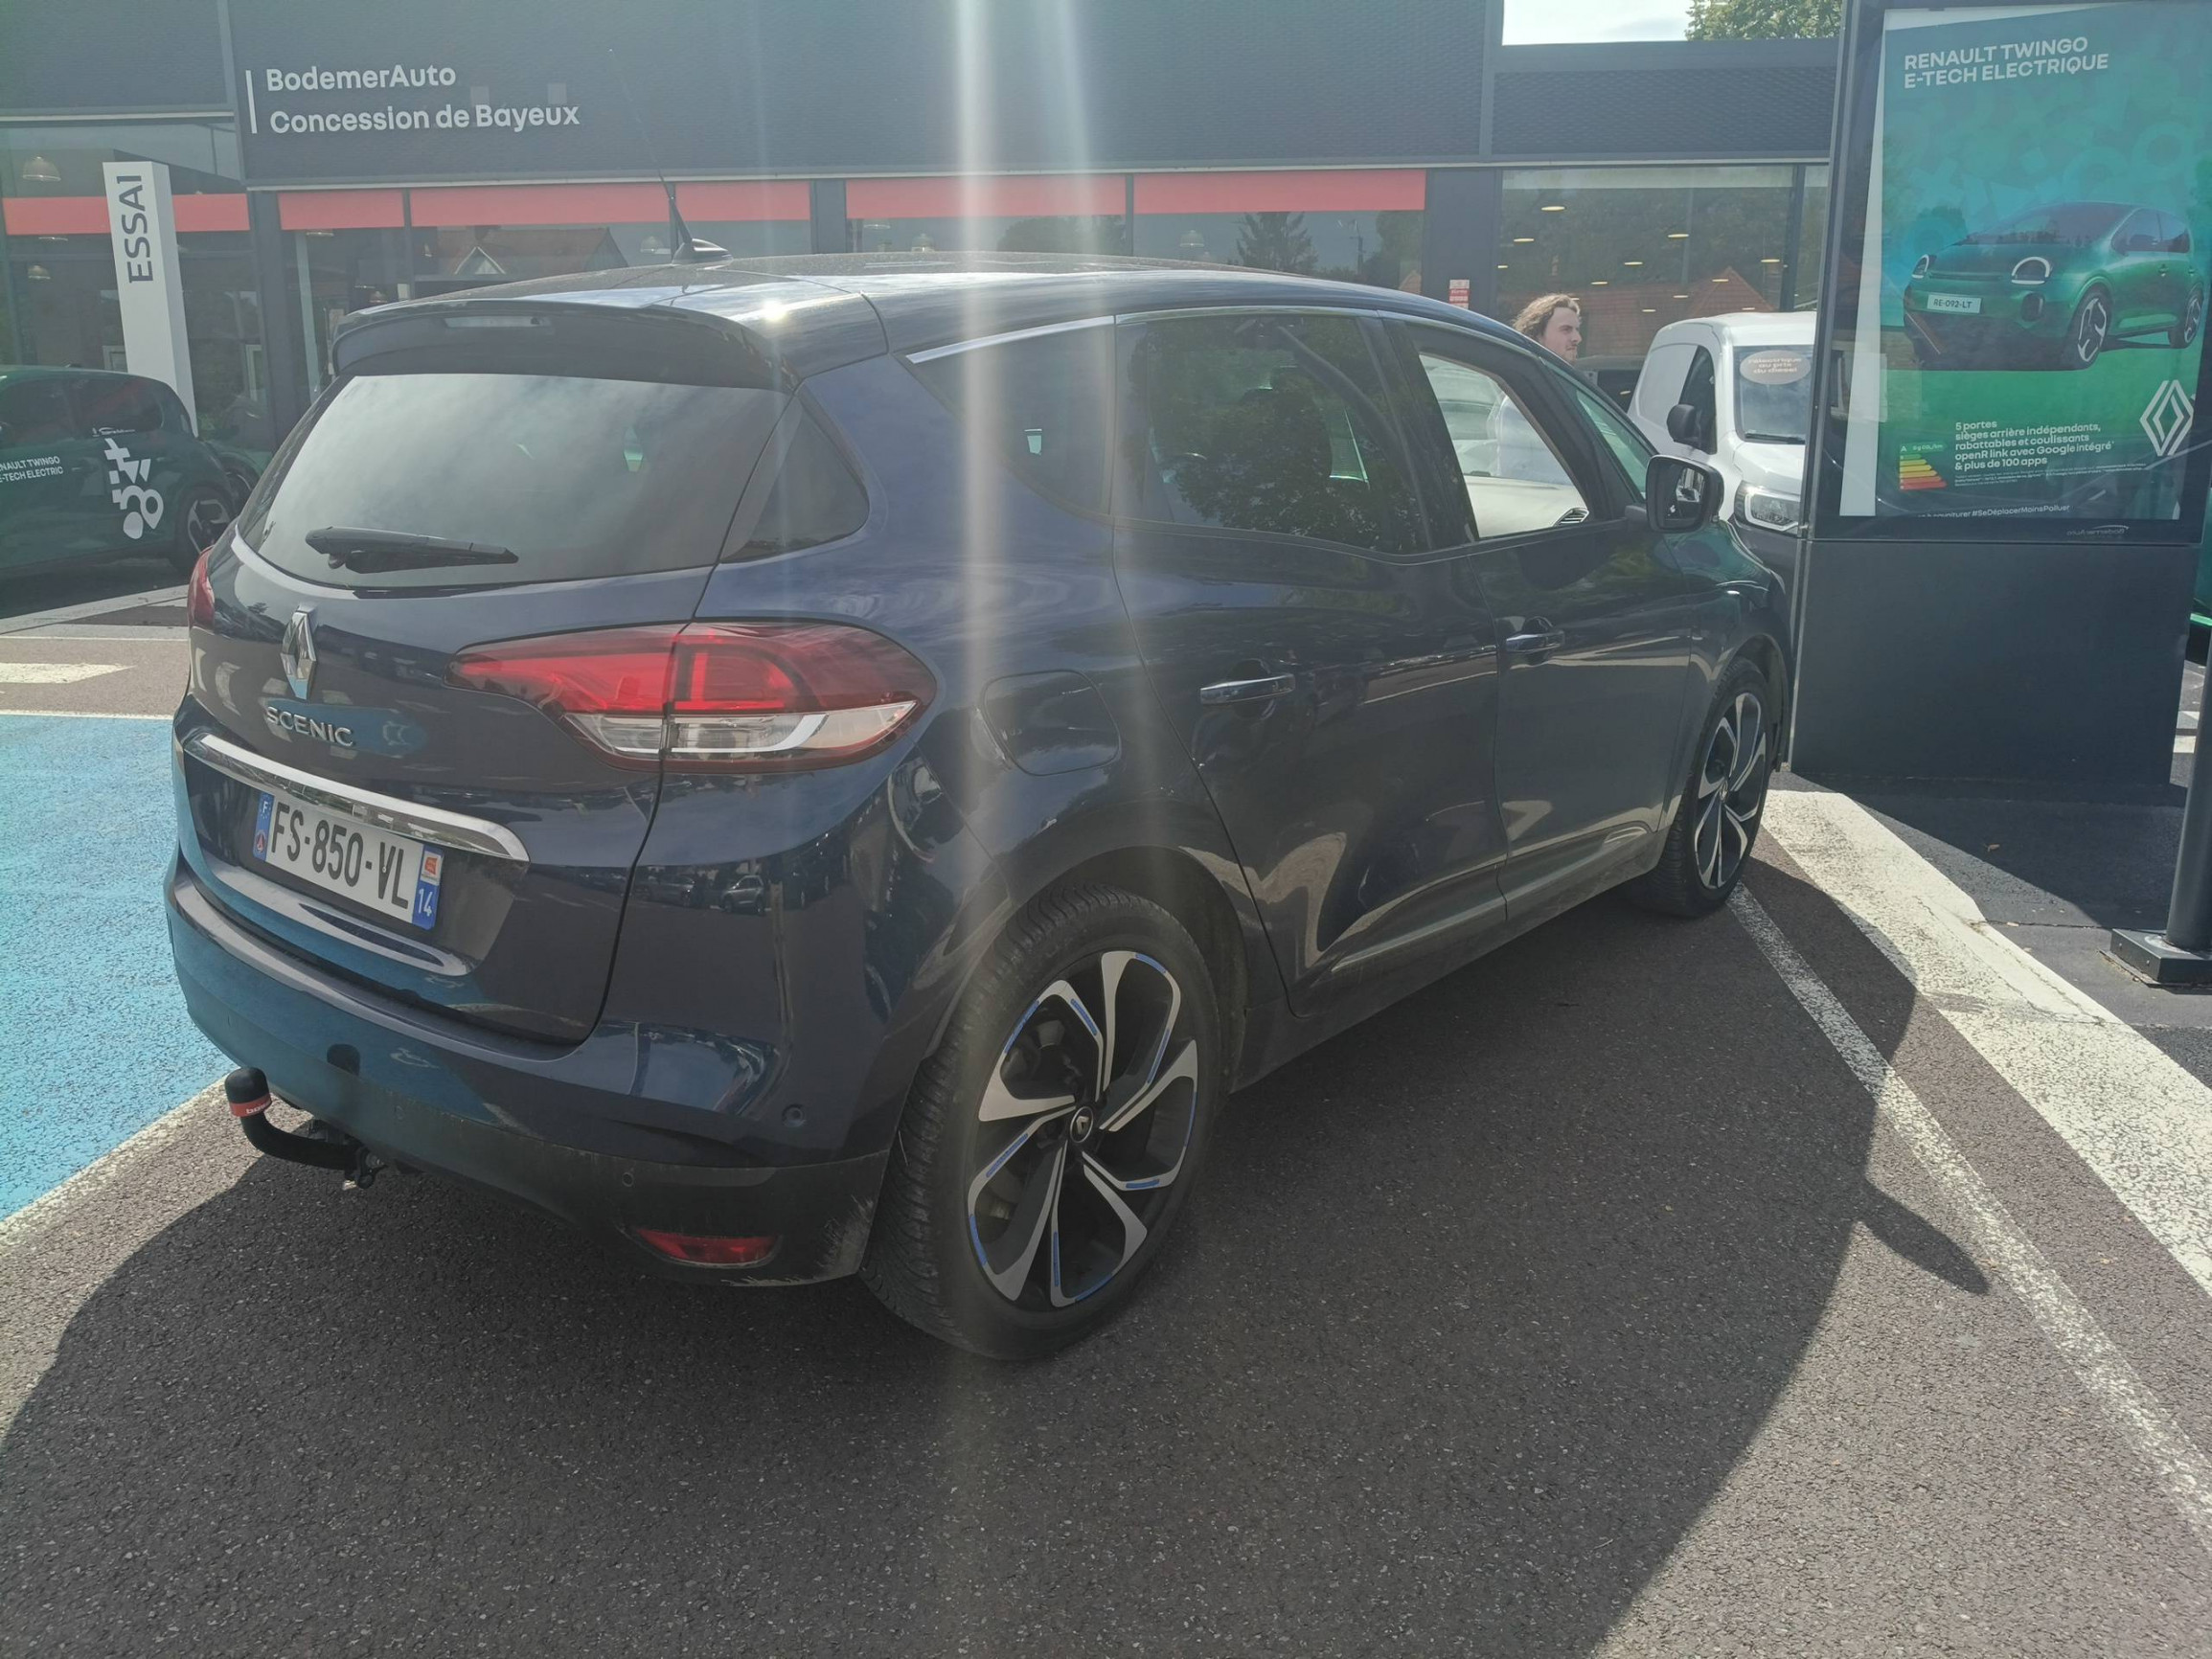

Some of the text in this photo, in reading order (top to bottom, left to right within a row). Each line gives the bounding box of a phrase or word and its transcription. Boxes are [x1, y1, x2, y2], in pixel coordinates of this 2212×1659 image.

[1904, 36, 2088, 70] RENAULT TWINGO
[265, 64, 457, 91] BodemerAuto
[1904, 54, 2109, 89] E-TECH ELECTRIQUE
[269, 104, 581, 133] Concession de Bayeux
[116, 175, 153, 284] ESSAI
[1933, 298, 1973, 309] RE-092-LT
[1955, 420, 1998, 434] 5 portes
[1955, 422, 2102, 443] sièges arrière indépendants,
[1955, 434, 2090, 450] rabattables et coulissants
[0, 456, 60, 471] NAULT TWINGO
[1955, 449, 1988, 463] openR
[1990, 447, 2008, 459] link
[2010, 448, 2035, 457] avec
[2037, 444, 2075, 456] Google
[26, 466, 63, 479] ELECTRIC
[1954, 461, 1963, 471] &
[1964, 459, 1986, 472] plus
[1987, 457, 2001, 468] de
[2002, 457, 2019, 467] 100
[2021, 457, 2048, 468] apps
[265, 705, 354, 747] SCENIC
[262, 800, 269, 813] F
[271, 802, 410, 910] FS-850-VL
[418, 888, 433, 918] 14
